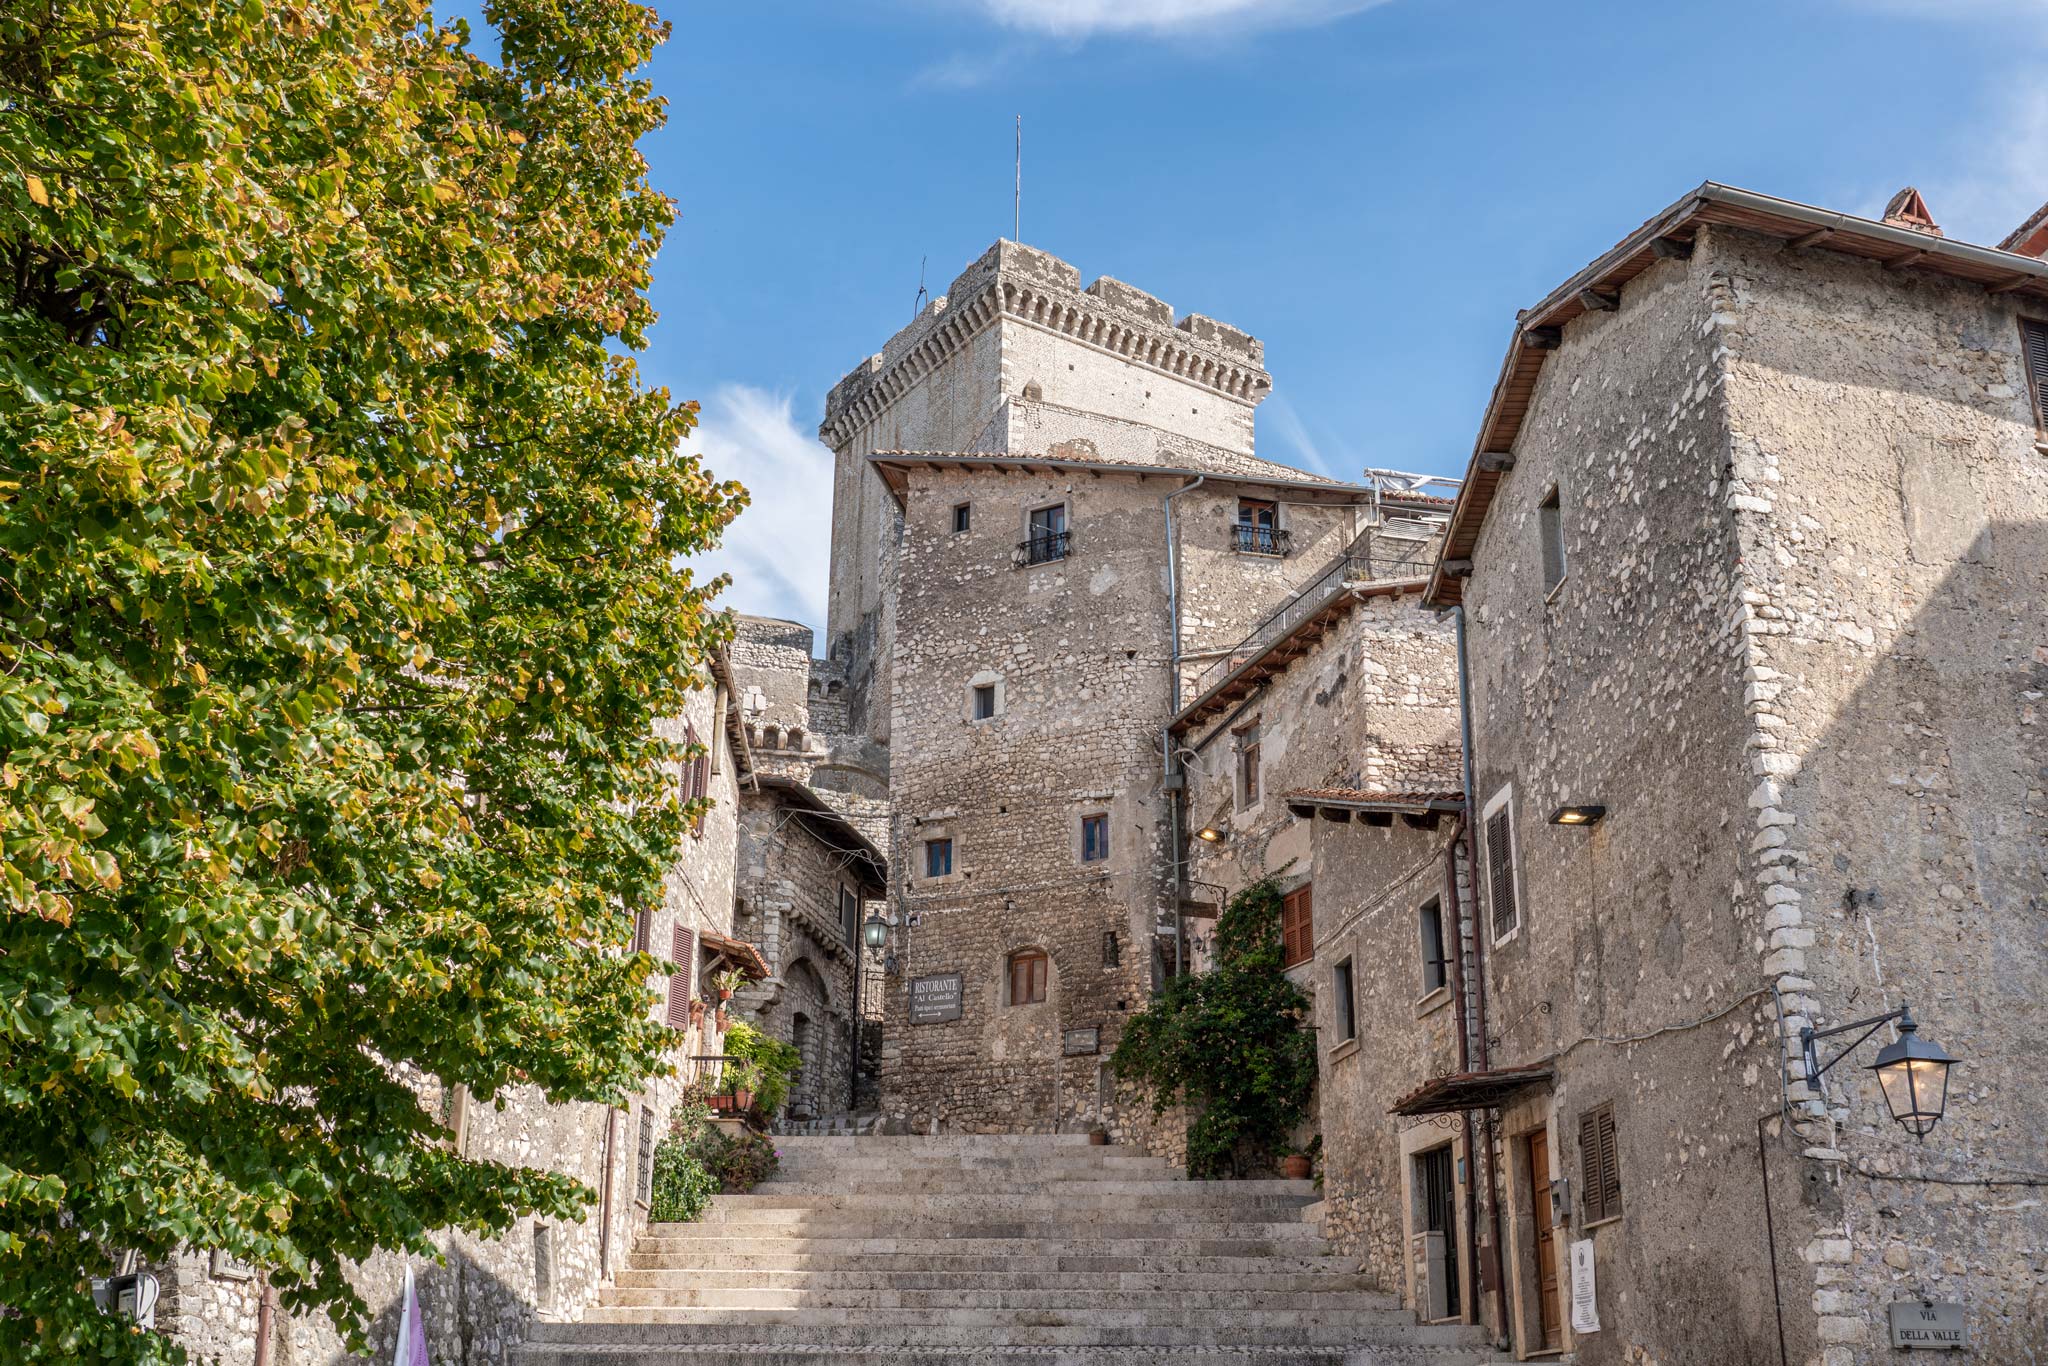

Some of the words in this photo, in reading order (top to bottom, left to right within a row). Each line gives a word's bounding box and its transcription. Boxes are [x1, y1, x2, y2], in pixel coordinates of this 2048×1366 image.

[915, 979, 957, 994] RISTORANTE
[1920, 1311, 1937, 1321] VIA
[1900, 1330, 1930, 1341] DELLA
[1932, 1331, 1961, 1341] VALLE
